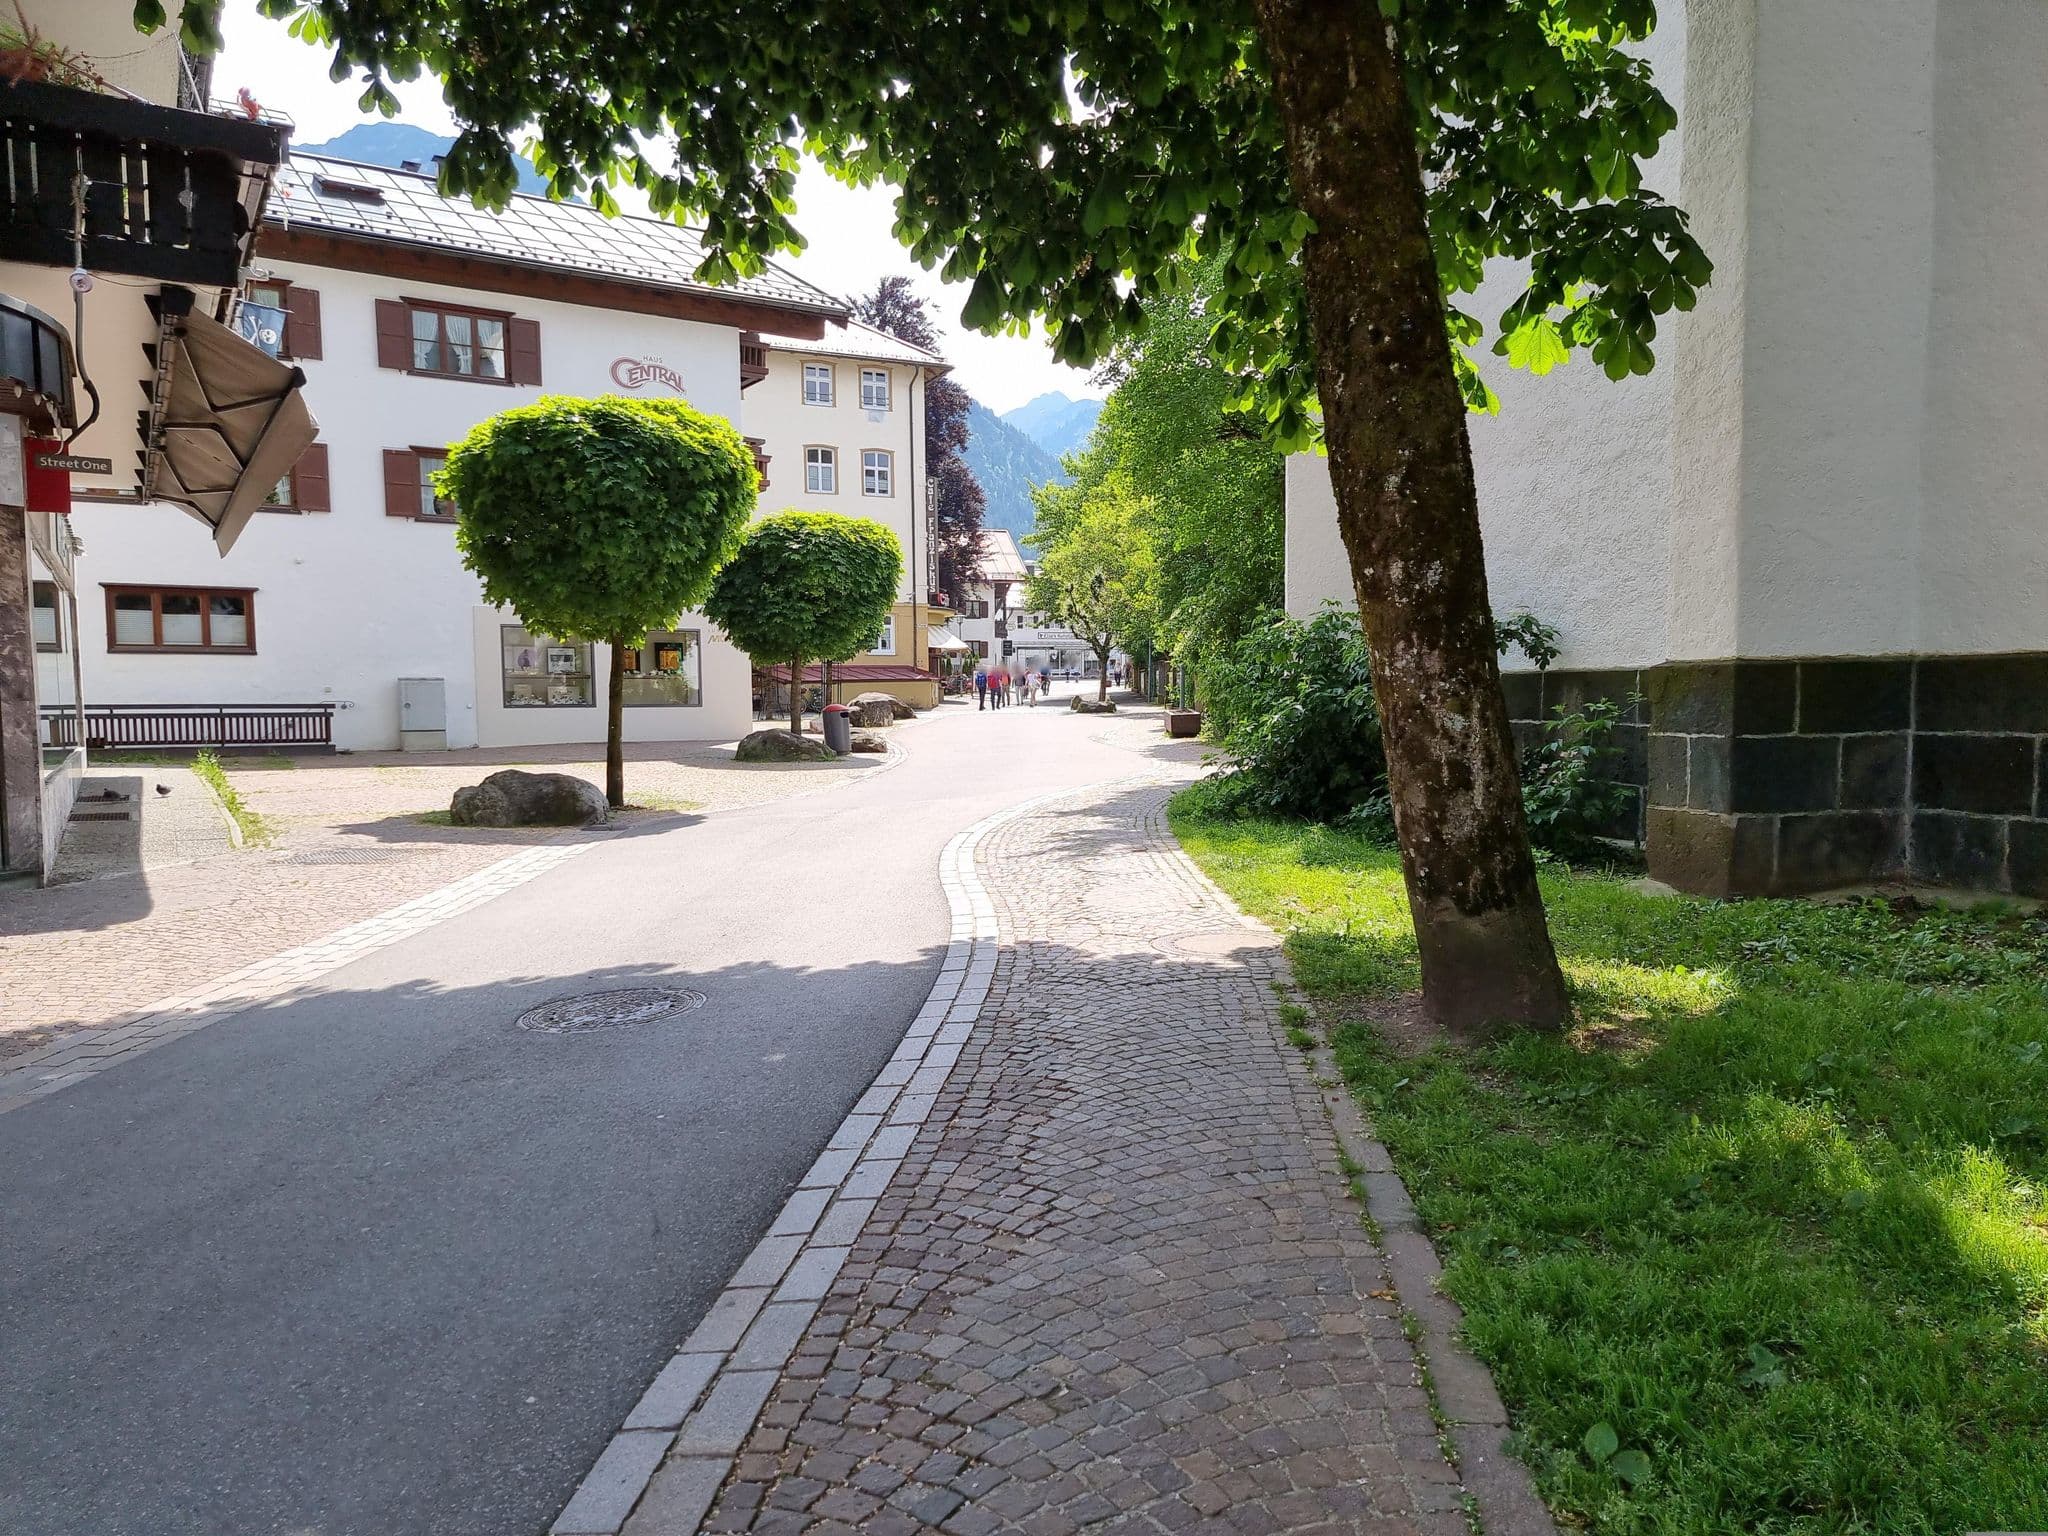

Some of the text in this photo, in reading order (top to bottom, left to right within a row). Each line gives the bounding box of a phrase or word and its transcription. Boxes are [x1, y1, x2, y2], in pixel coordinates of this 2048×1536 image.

[643, 355, 663, 364] HAUS
[610, 357, 685, 392] CENTRAL
[40, 457, 108, 471] Street One
